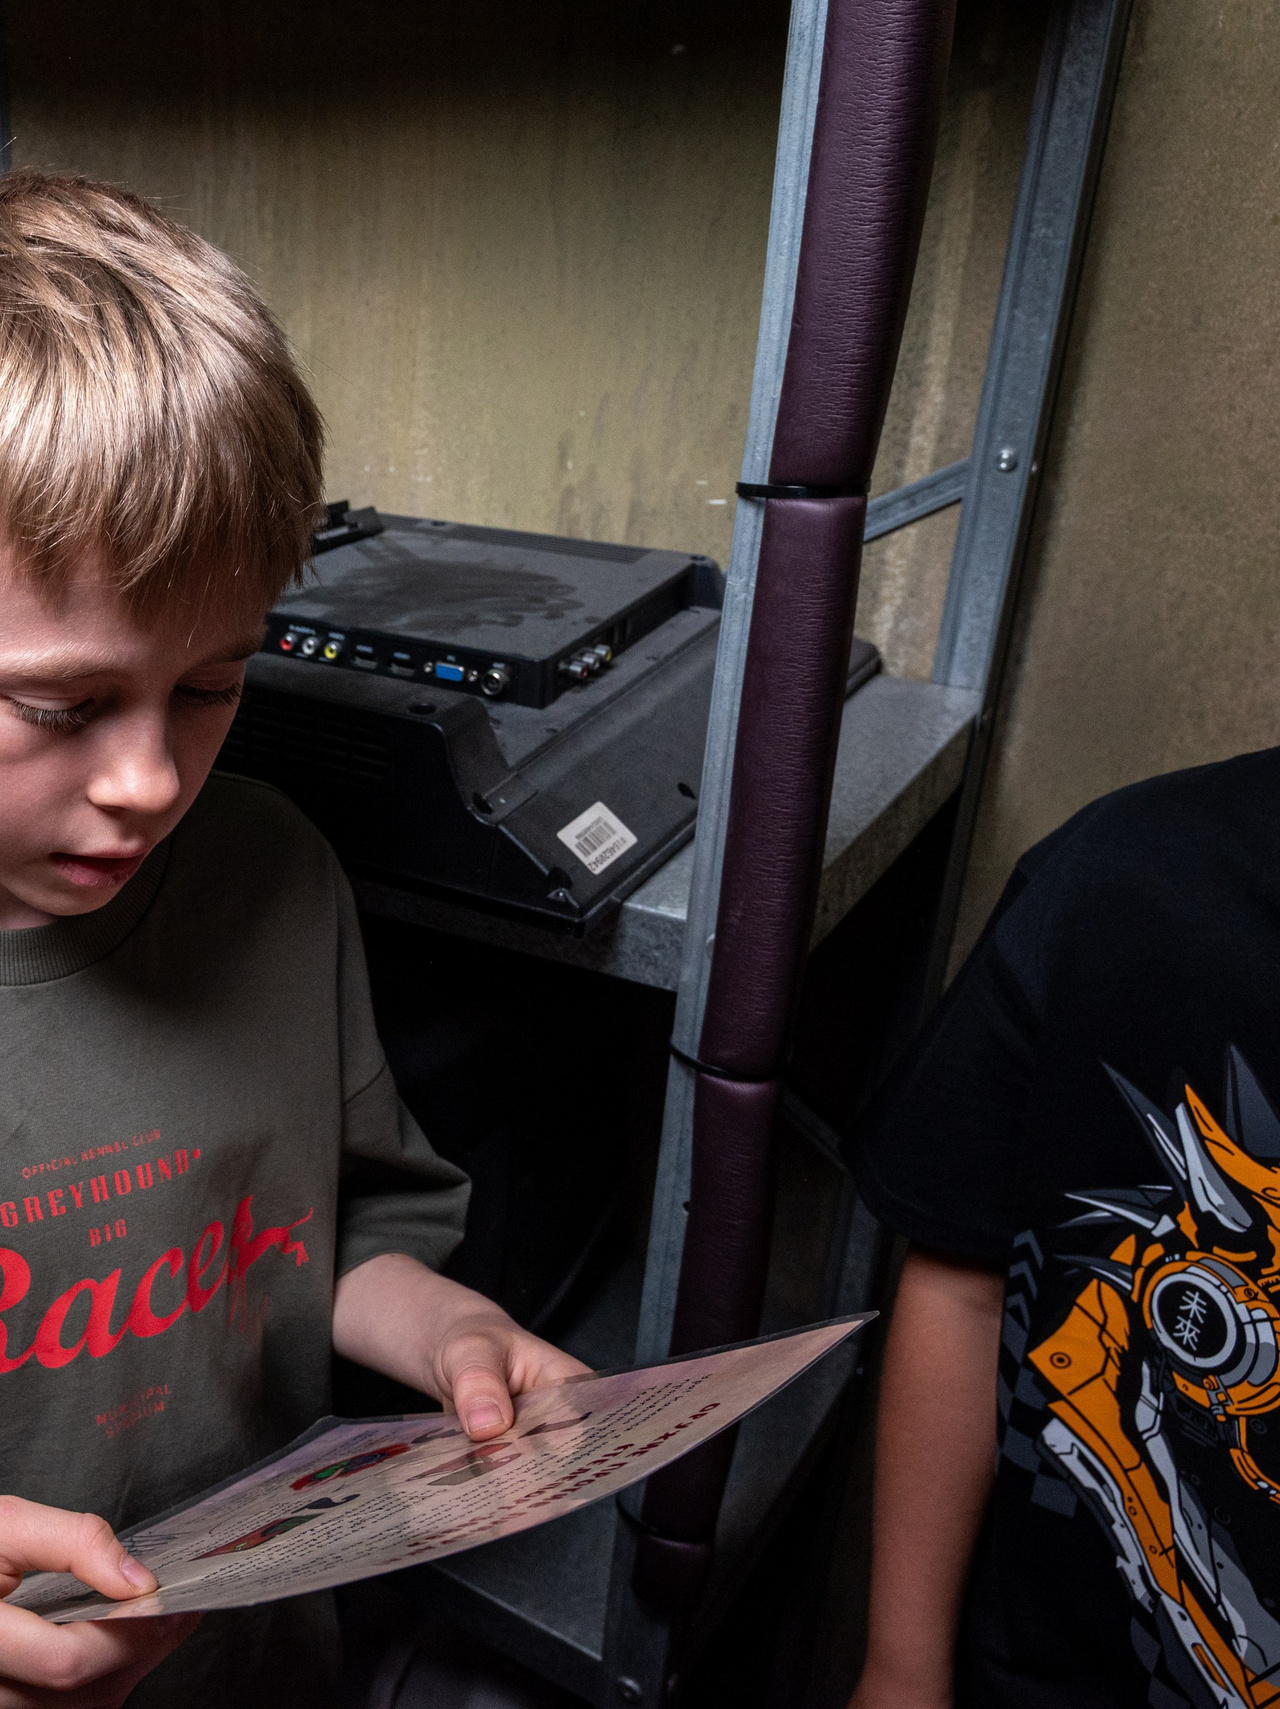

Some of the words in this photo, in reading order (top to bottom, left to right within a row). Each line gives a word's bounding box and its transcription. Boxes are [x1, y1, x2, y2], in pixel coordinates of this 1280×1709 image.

[21, 1156, 78, 1179] OFFICIAL
[81, 1140, 128, 1161] KENNEL
[131, 1129, 161, 1147] CLUB
[0, 1148, 189, 1228] GREYHOUND
[89, 1219, 127, 1247] BIG
